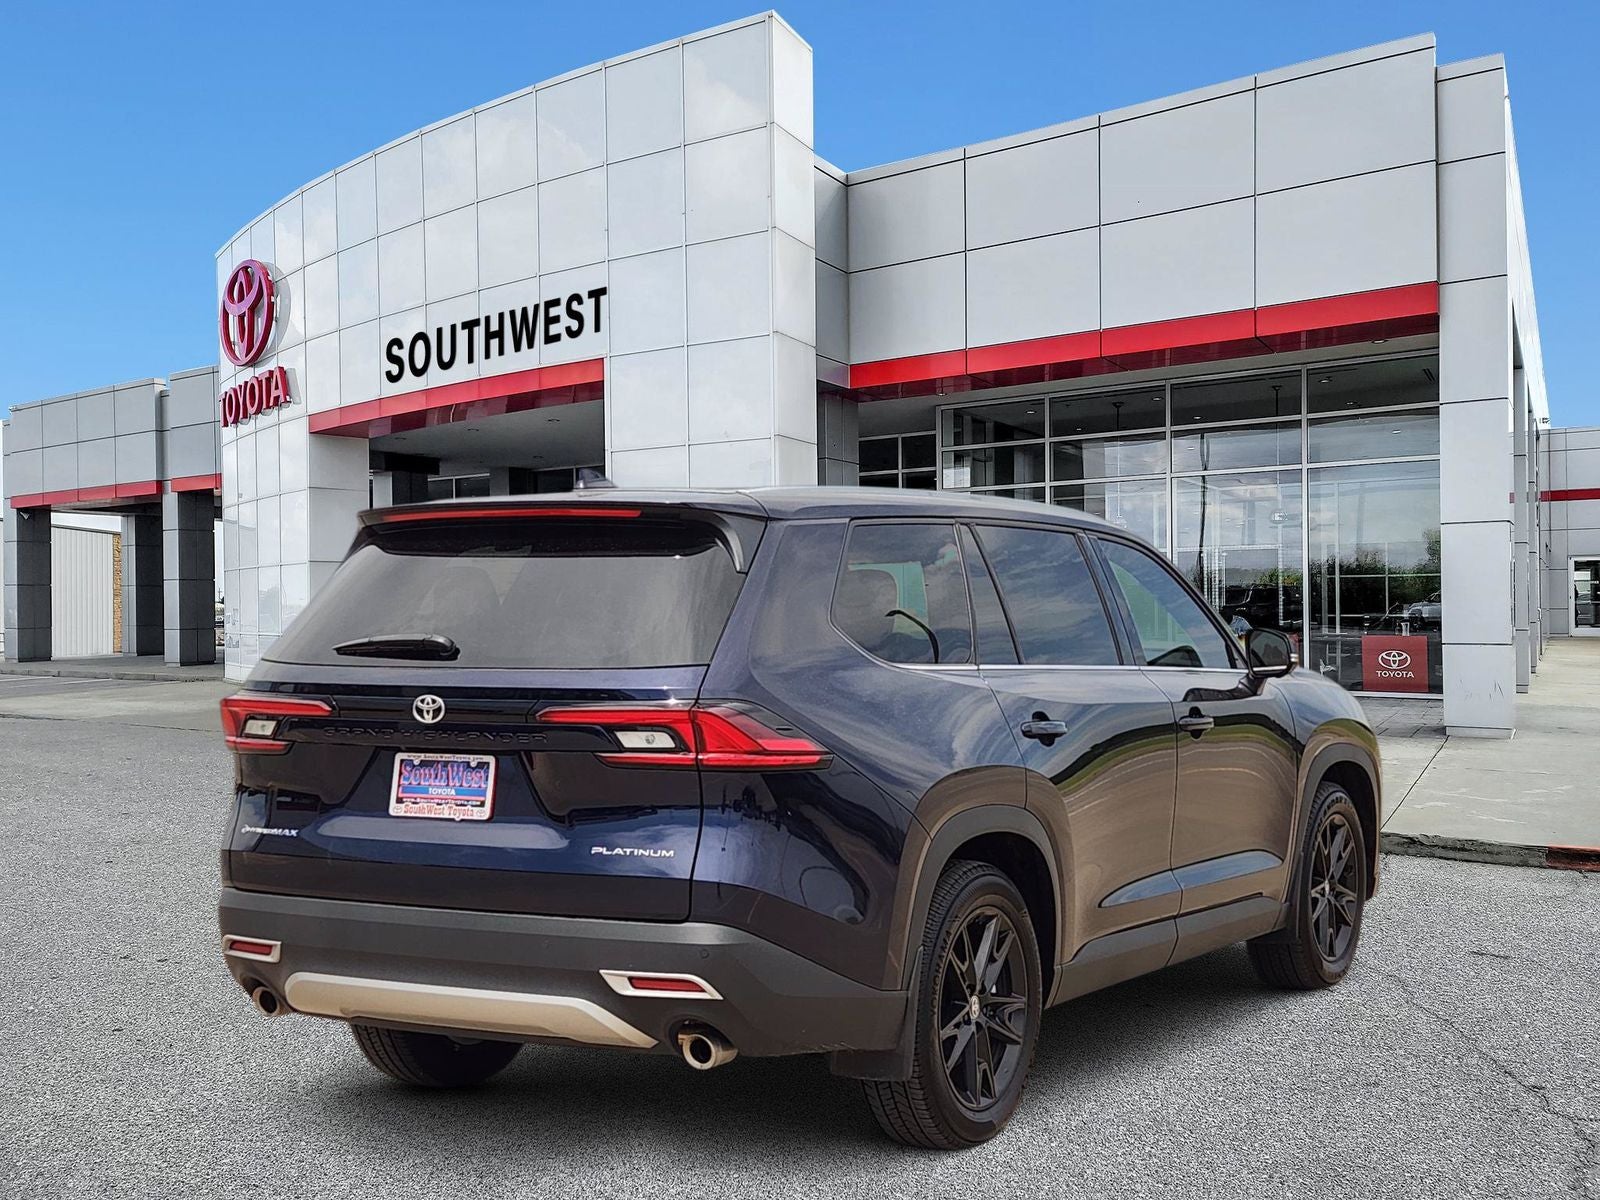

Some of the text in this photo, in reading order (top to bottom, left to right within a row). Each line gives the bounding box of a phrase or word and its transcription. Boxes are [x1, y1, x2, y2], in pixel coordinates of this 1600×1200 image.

[385, 286, 608, 384] SOUTHWEST
[219, 366, 291, 427] TOYOTA
[1376, 670, 1415, 678] TOYOTA
[428, 787, 456, 796] TOYOTA
[448, 804, 475, 818] Toyota
[591, 846, 675, 858] PLATINUM
[930, 930, 952, 1017] YOKOHAMA
